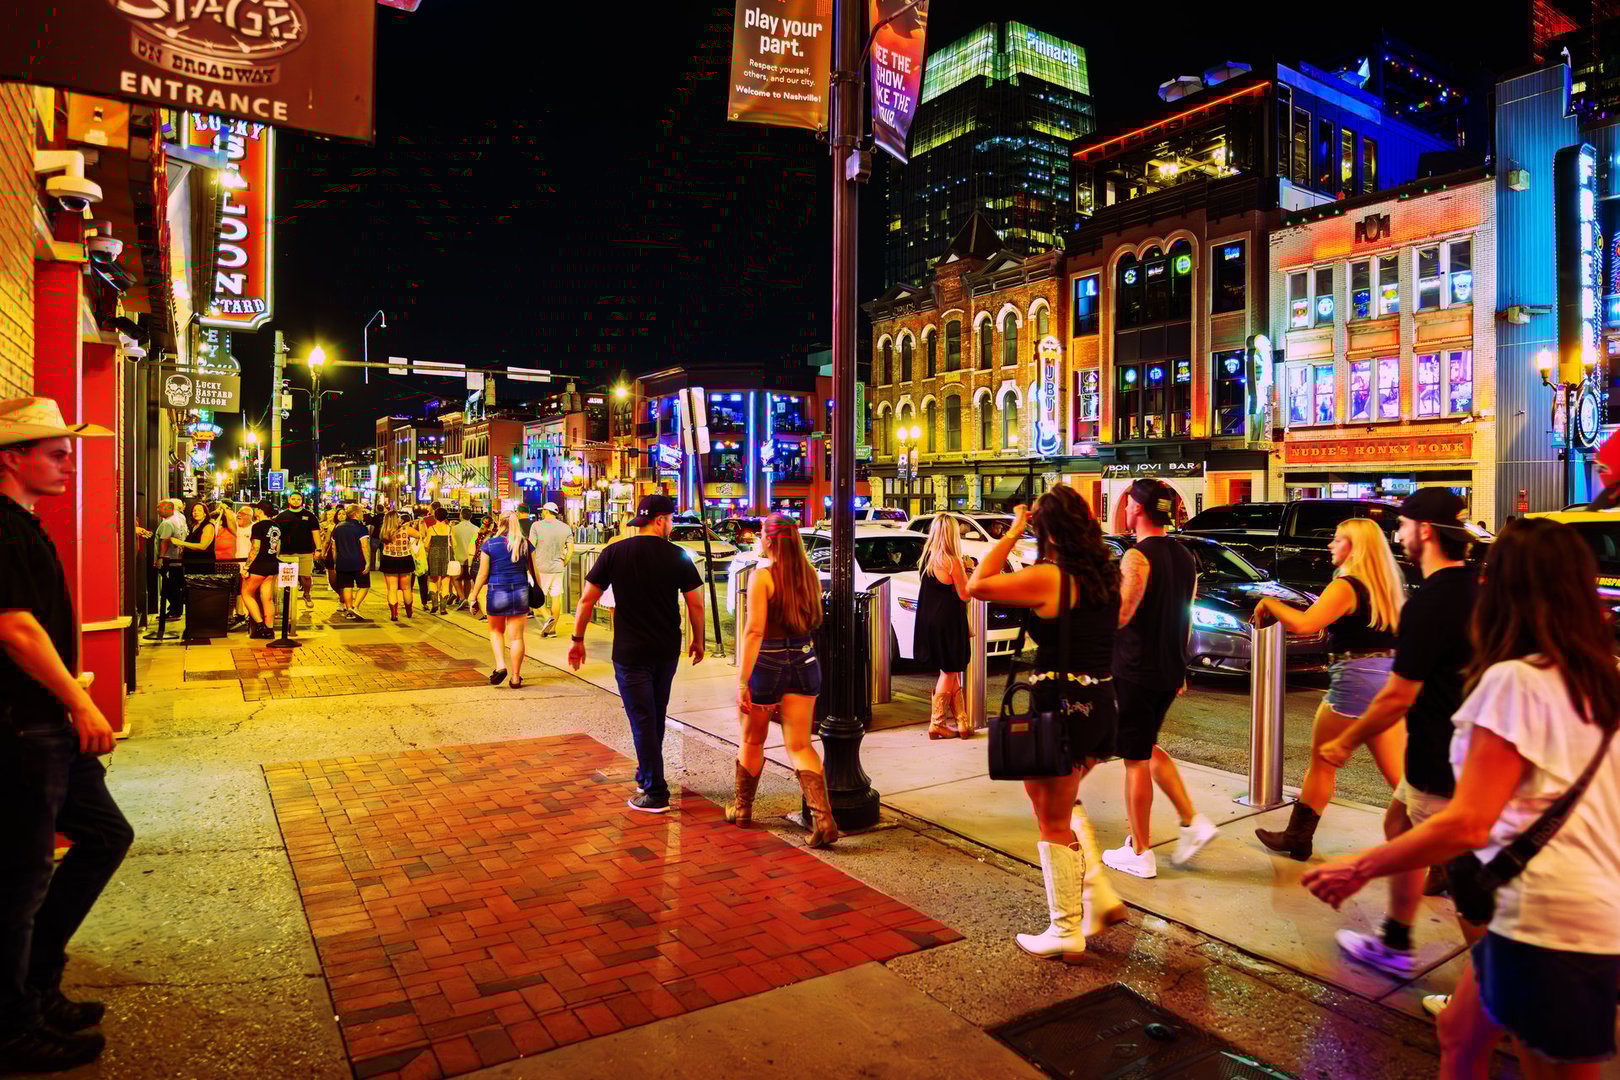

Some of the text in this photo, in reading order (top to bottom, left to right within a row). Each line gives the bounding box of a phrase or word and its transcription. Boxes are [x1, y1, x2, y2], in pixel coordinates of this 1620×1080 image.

[745, 7, 822, 37] play your
[760, 35, 804, 57] part.
[1026, 31, 1078, 67] Pinnacle
[137, 39, 276, 83] ON BROADWAY
[749, 59, 811, 76] Respect yourself,
[891, 52, 912, 74] THE
[743, 70, 769, 81] others,
[801, 79, 816, 87] city.
[876, 64, 905, 91] SHOW.
[120, 70, 288, 121] ENTRANCE
[735, 84, 821, 103] Welcome to Nashville!
[893, 91, 911, 114] THE
[195, 379, 222, 390] LUCKY
[195, 388, 233, 399] BASTARD
[195, 396, 227, 406] SALOON
[1291, 443, 1465, 457] NUDIE'S HONKY TONK
[1136, 463, 1161, 472] JOVI
[1169, 462, 1195, 470] BAR
